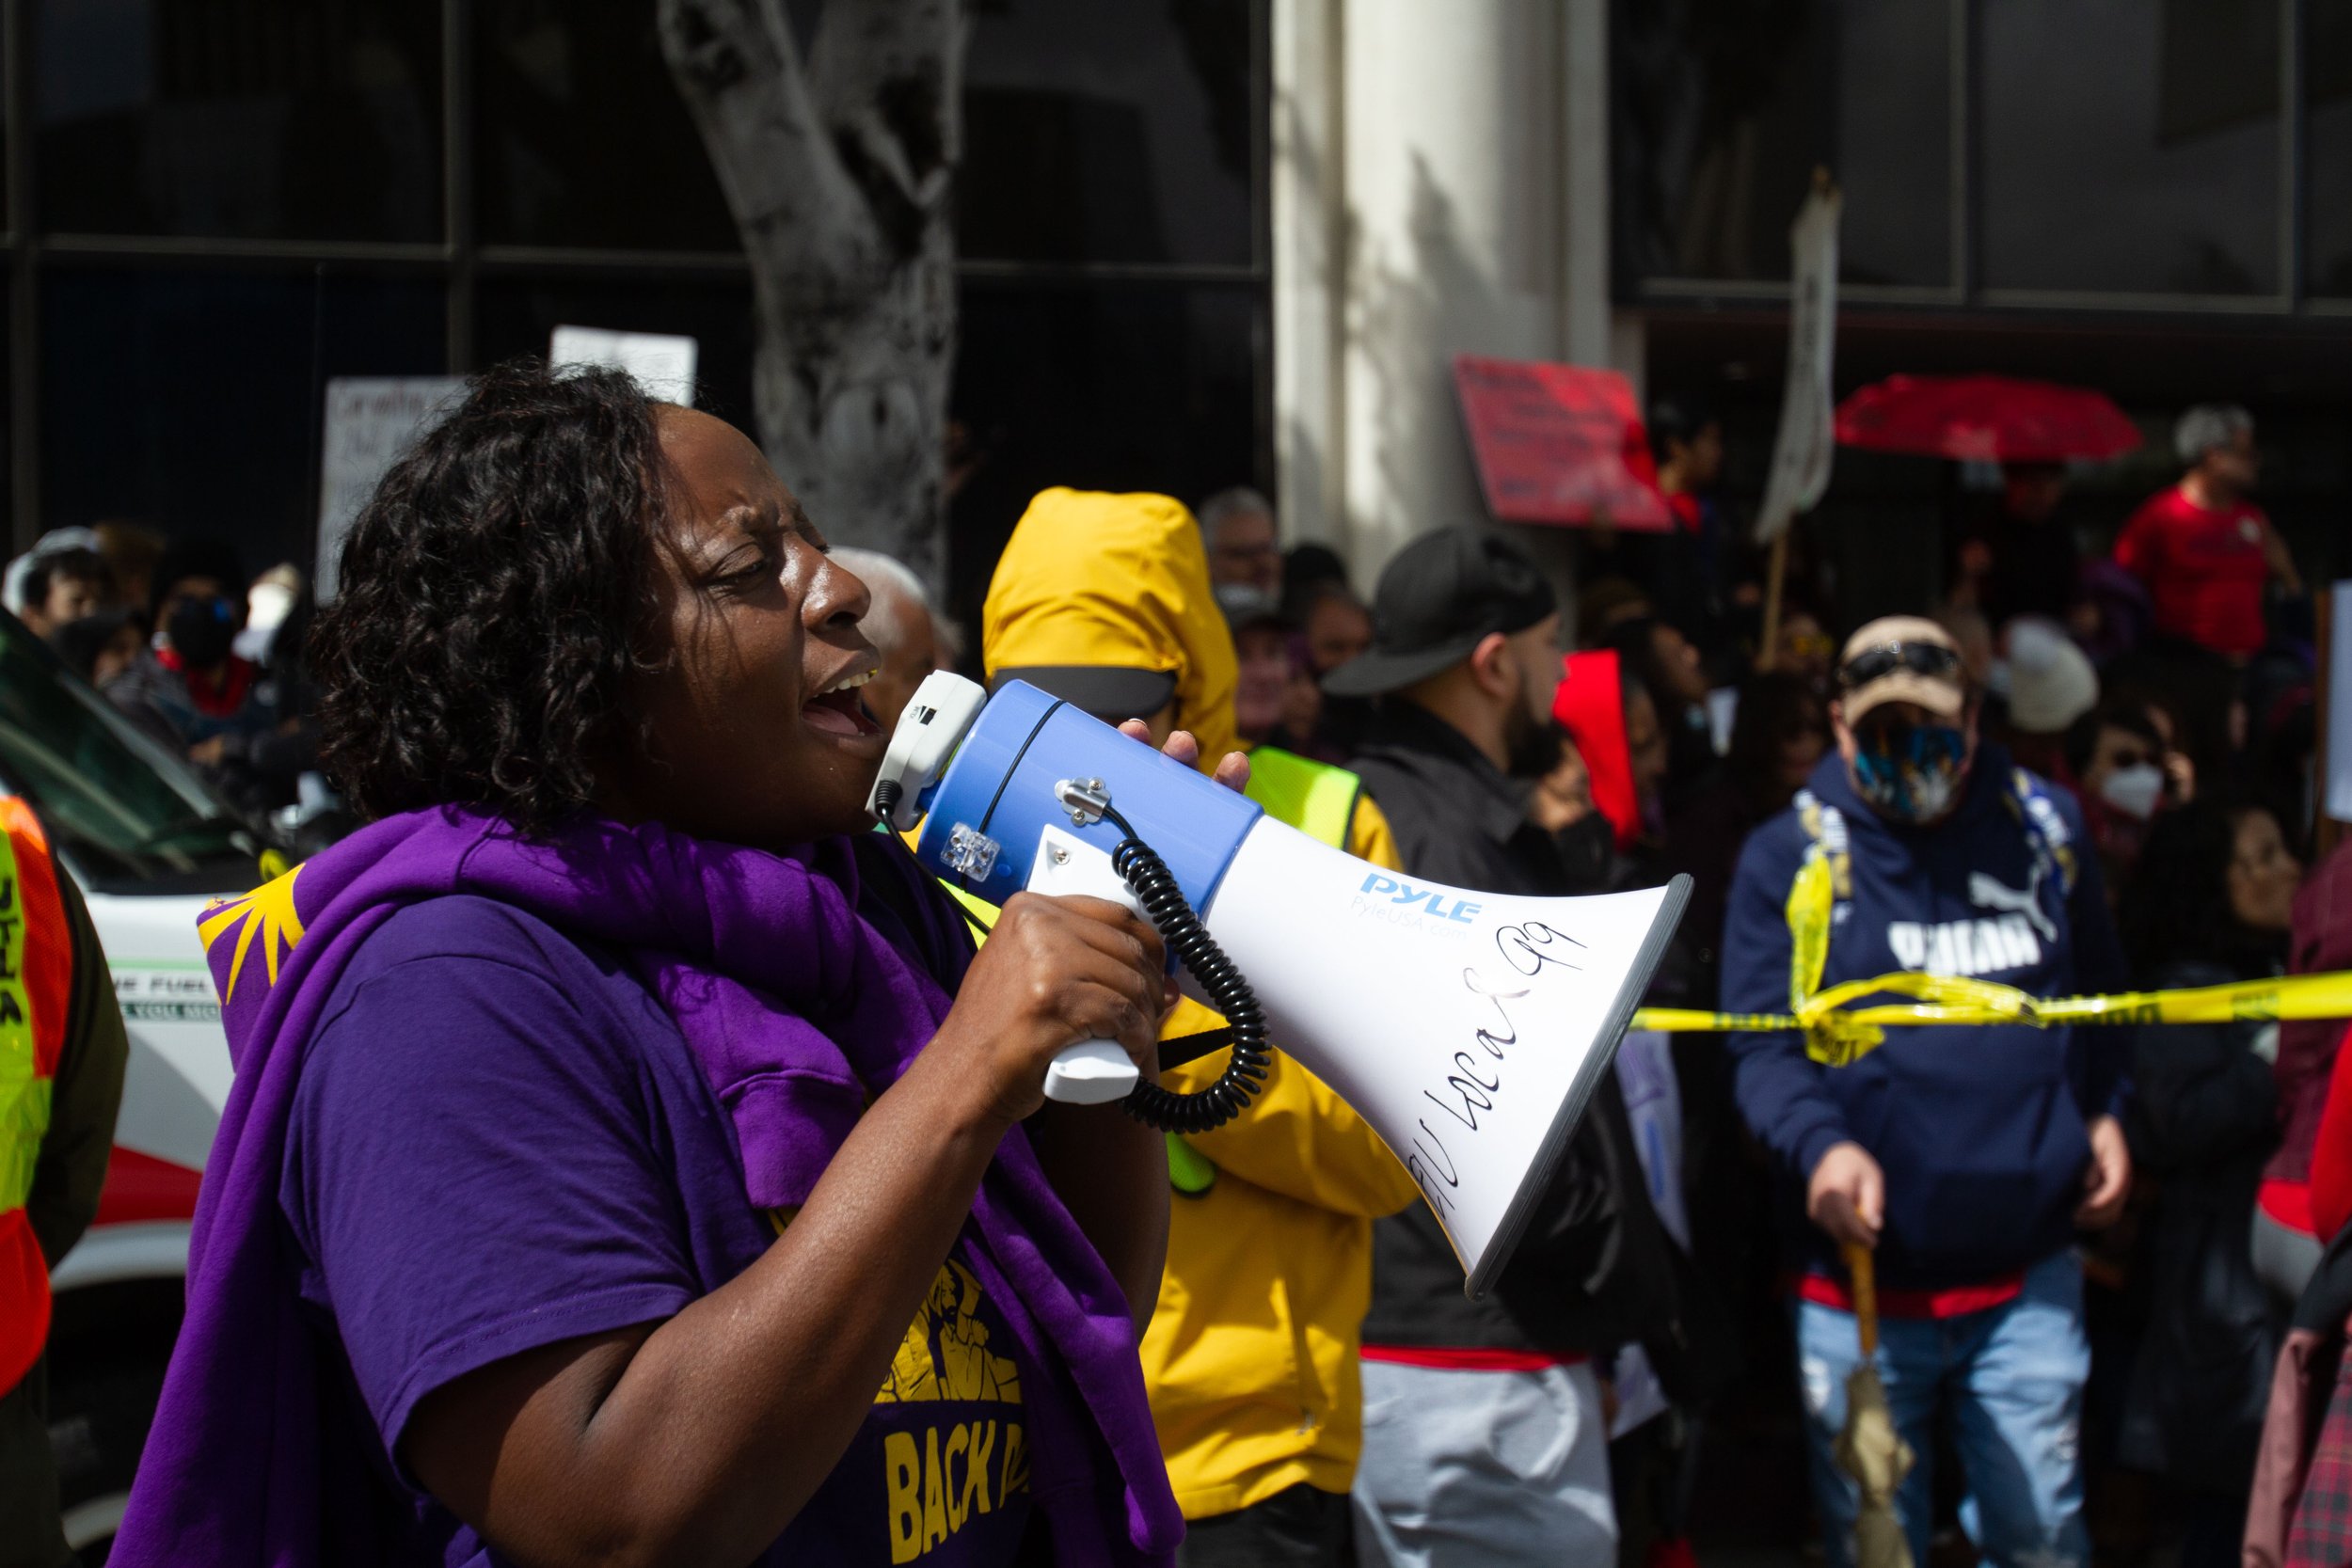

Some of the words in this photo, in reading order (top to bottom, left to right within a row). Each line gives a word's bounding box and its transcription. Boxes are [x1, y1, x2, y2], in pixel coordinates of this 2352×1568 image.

[1350, 895, 1468, 940] PyleUSAcom
[1360, 873, 1483, 925] PYLE
[1496, 921, 1588, 975] 99
[884, 1418, 996, 1566] BACK
